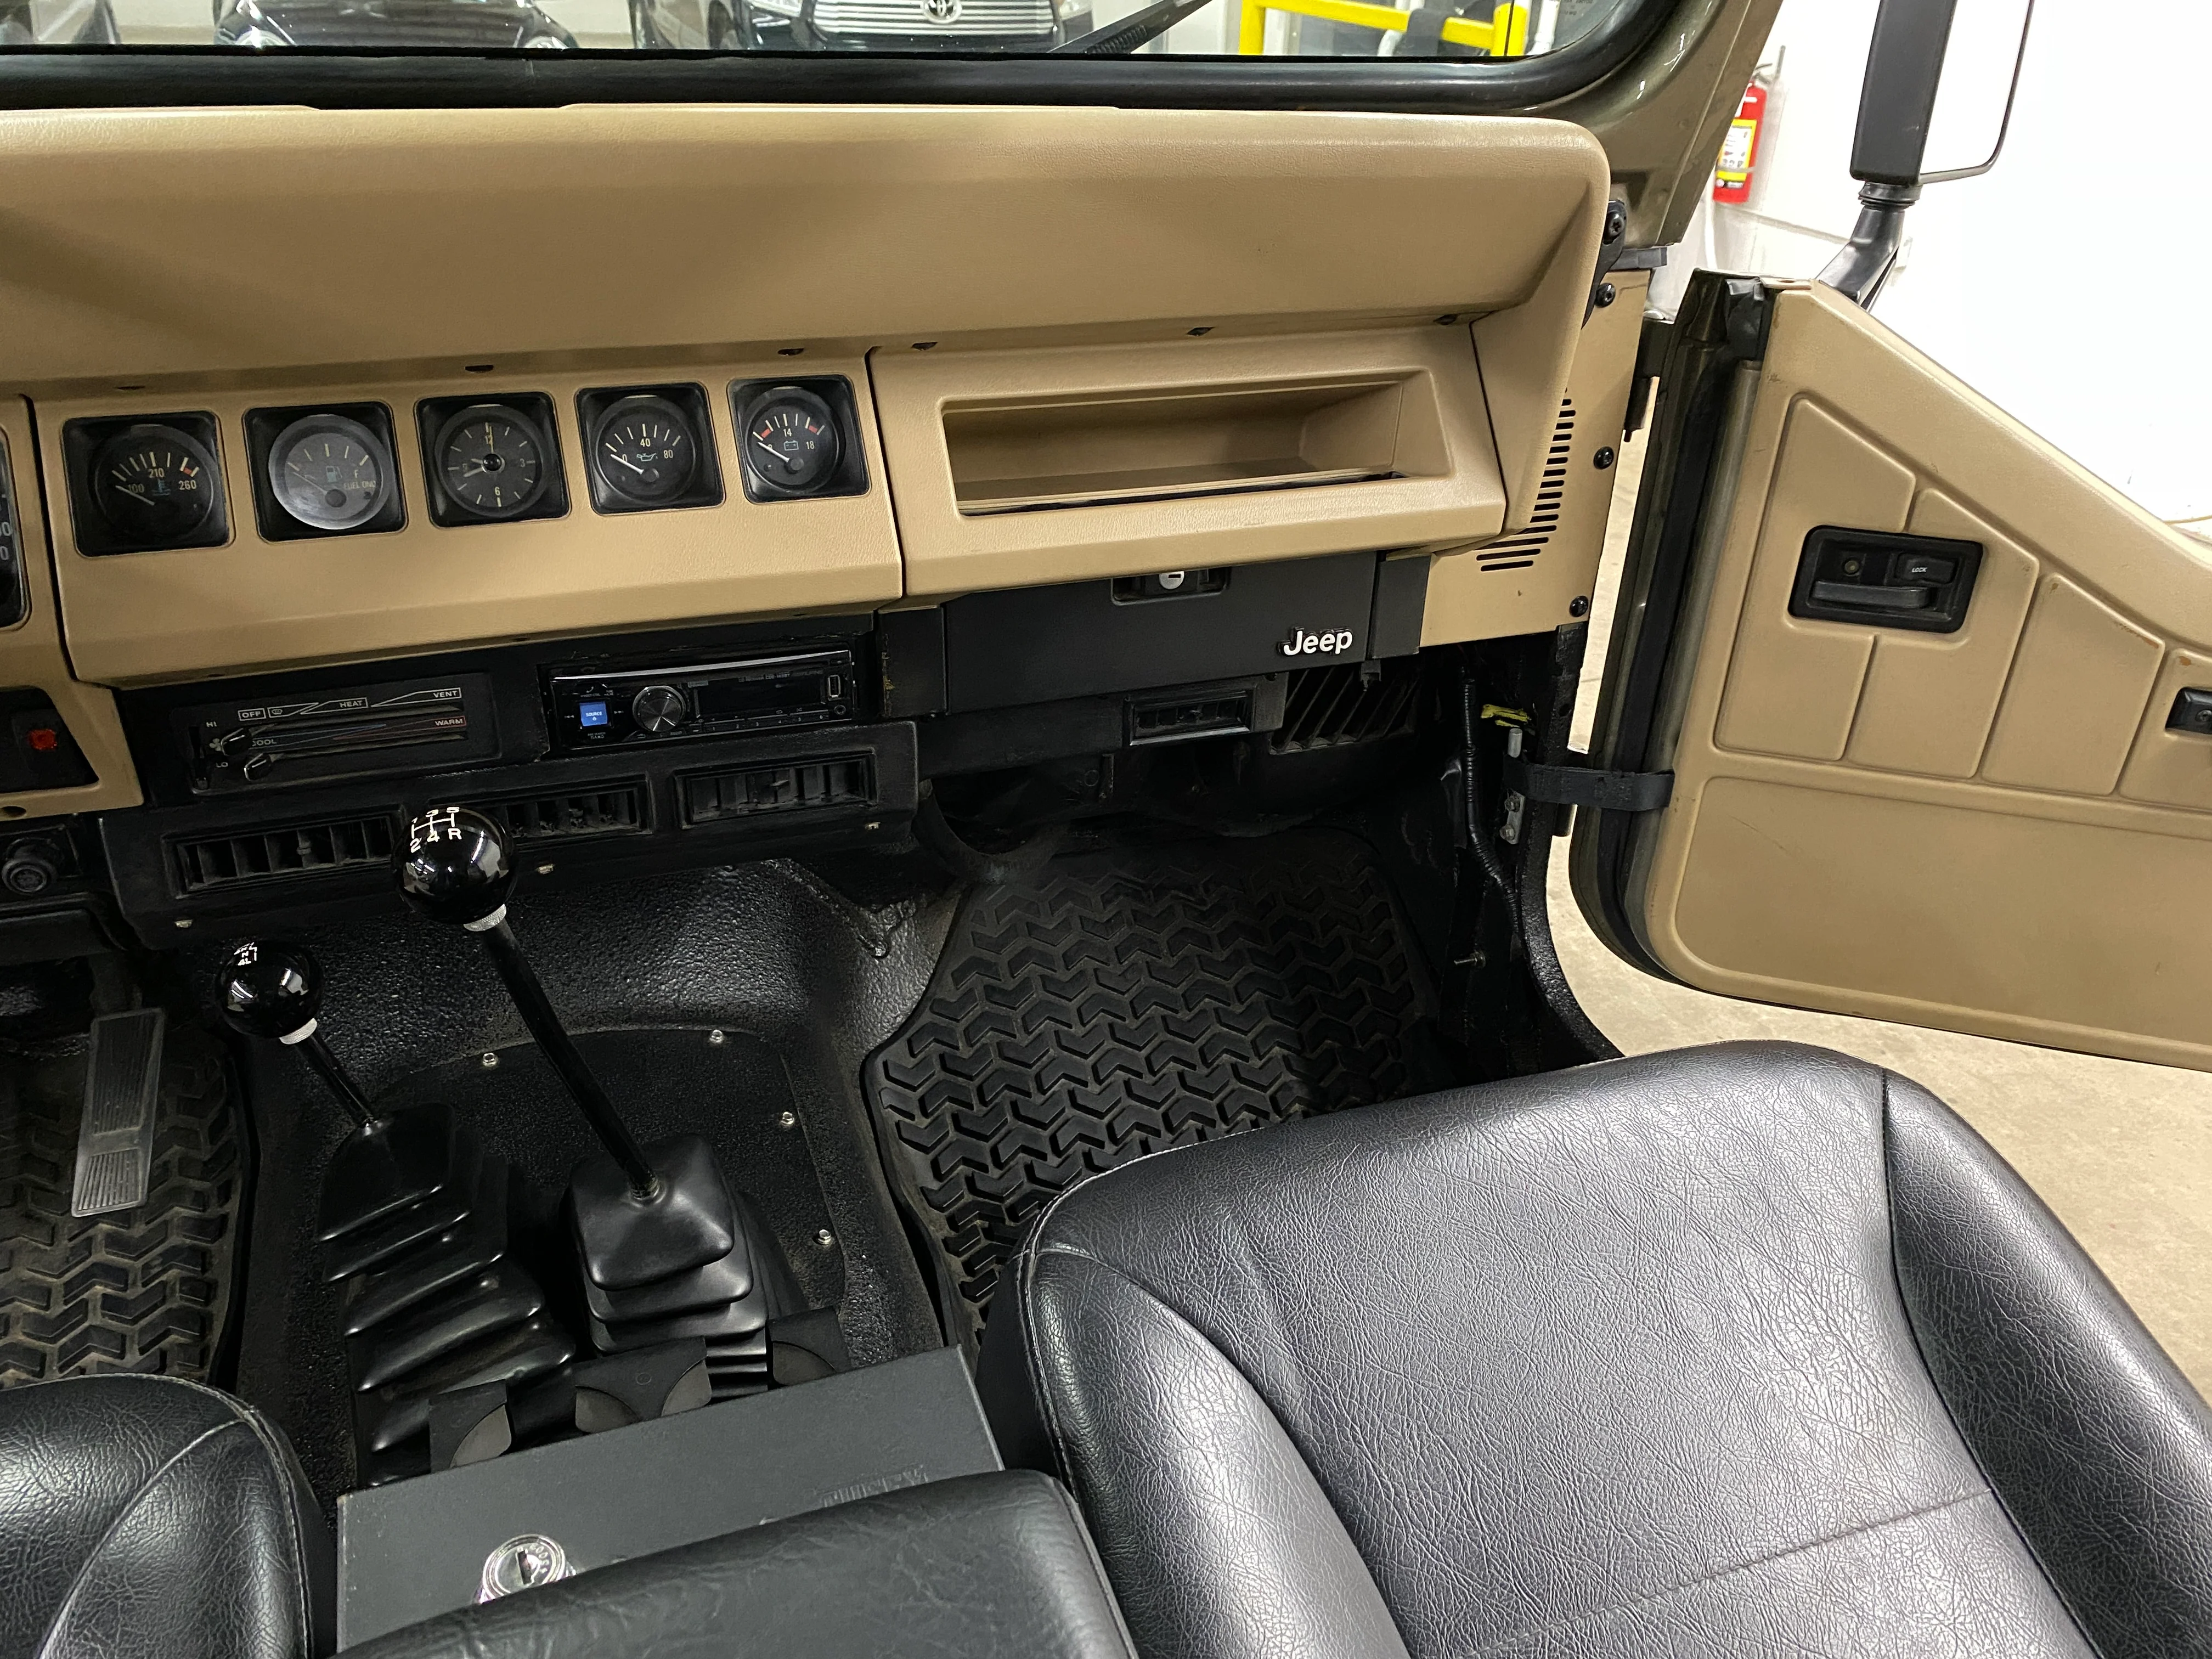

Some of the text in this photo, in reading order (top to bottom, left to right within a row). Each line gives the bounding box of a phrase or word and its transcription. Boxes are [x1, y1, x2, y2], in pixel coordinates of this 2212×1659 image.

[783, 428, 792, 437] 14
[640, 438, 651, 447] 40
[806, 441, 815, 449] 18
[663, 449, 674, 459] 80
[520, 459, 525, 467] 3
[149, 468, 165, 478] 210
[354, 469, 359, 478] F
[128, 483, 145, 493] 100
[178, 480, 197, 490] 260
[495, 487, 500, 495] 6
[1283, 630, 1353, 656] Jeep
[434, 718, 463, 726] WARM
[426, 809, 439, 817] 3
[410, 828, 462, 853] 2 4 R
